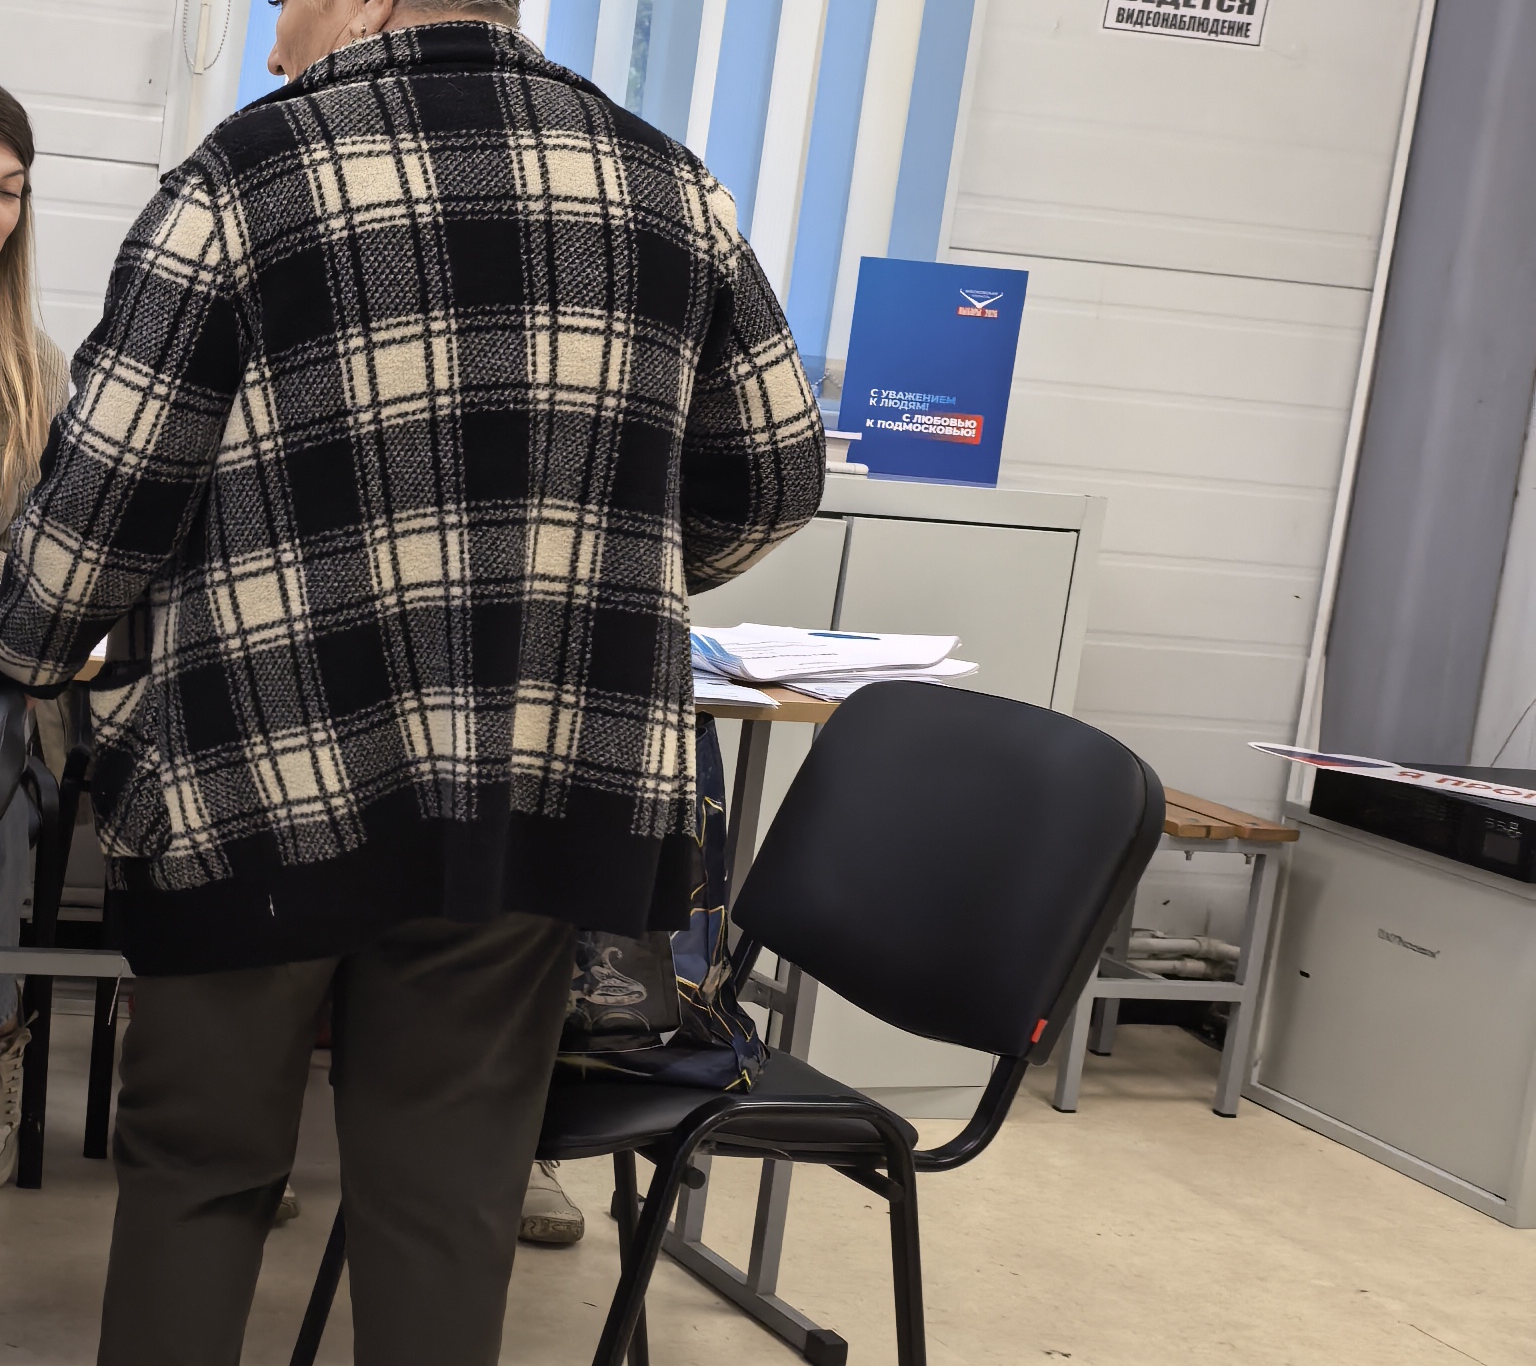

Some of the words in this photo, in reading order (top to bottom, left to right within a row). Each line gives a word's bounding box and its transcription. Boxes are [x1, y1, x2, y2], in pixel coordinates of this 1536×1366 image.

[1115, 7, 1252, 39] ВИДЕОНАБЛЮДЕНИЕ
[869, 397, 878, 406] К
[879, 398, 930, 411] ЛЮДЯМ!
[870, 388, 879, 397] С
[881, 389, 957, 405] УВАЖЕНИЕМ
[865, 418, 875, 428] К
[877, 419, 976, 438] ПОДМОСКОВЬЮ!
[902, 413, 911, 422] С
[912, 414, 977, 429] ЛЮБОВЬЮ
[1396, 771, 1424, 780] Я
